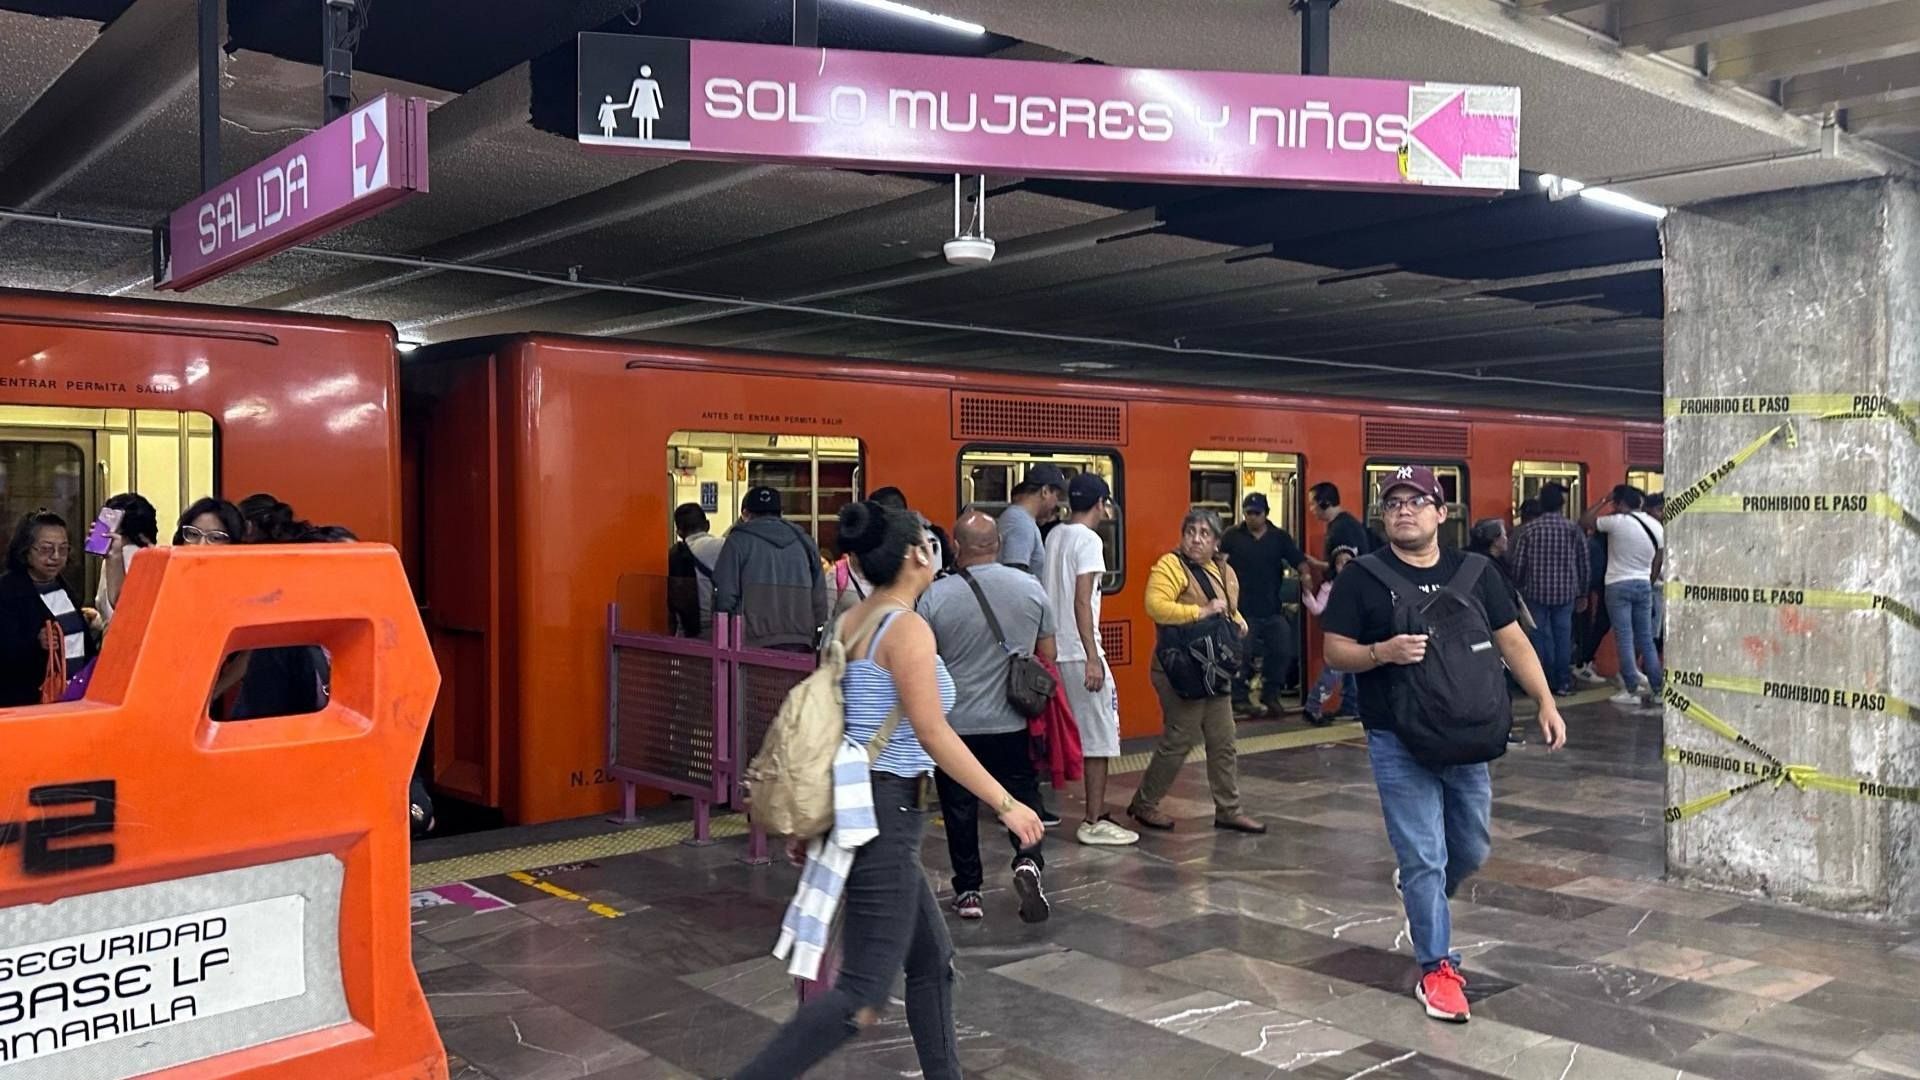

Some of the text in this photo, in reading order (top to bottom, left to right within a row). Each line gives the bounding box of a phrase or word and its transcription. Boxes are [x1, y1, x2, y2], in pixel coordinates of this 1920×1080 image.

[704, 77, 1408, 152] SOLO MUJERES Y NIÑOS
[198, 153, 309, 256] SALIDA
[0, 377, 57, 390] ENTRAR
[67, 380, 127, 393] PERMITA
[1680, 398, 1739, 414] PROHIBIDO
[1743, 398, 1756, 413] EL
[1759, 396, 1790, 413] PASO
[701, 411, 843, 426] ANTES DE ENTRAR PERMITA SALIR
[1698, 479, 1713, 494] EL
[1710, 460, 1736, 483] PASO
[1743, 495, 1867, 512] PROHIBIDO EL PASO
[1684, 584, 1749, 602] PROHIBIDO
[1753, 588, 1768, 604] EL
[1771, 589, 1804, 605] PASO
[1664, 686, 1690, 712] PASO
[1673, 670, 1704, 688] PASO
[1763, 681, 1830, 705] PROHIBIDO
[1833, 690, 1848, 707] EL
[1851, 692, 1886, 712] PASO
[1680, 749, 1740, 773] PROHIBIDO
[1744, 761, 1758, 776] EL
[0, 995, 197, 1062] MARILLA
